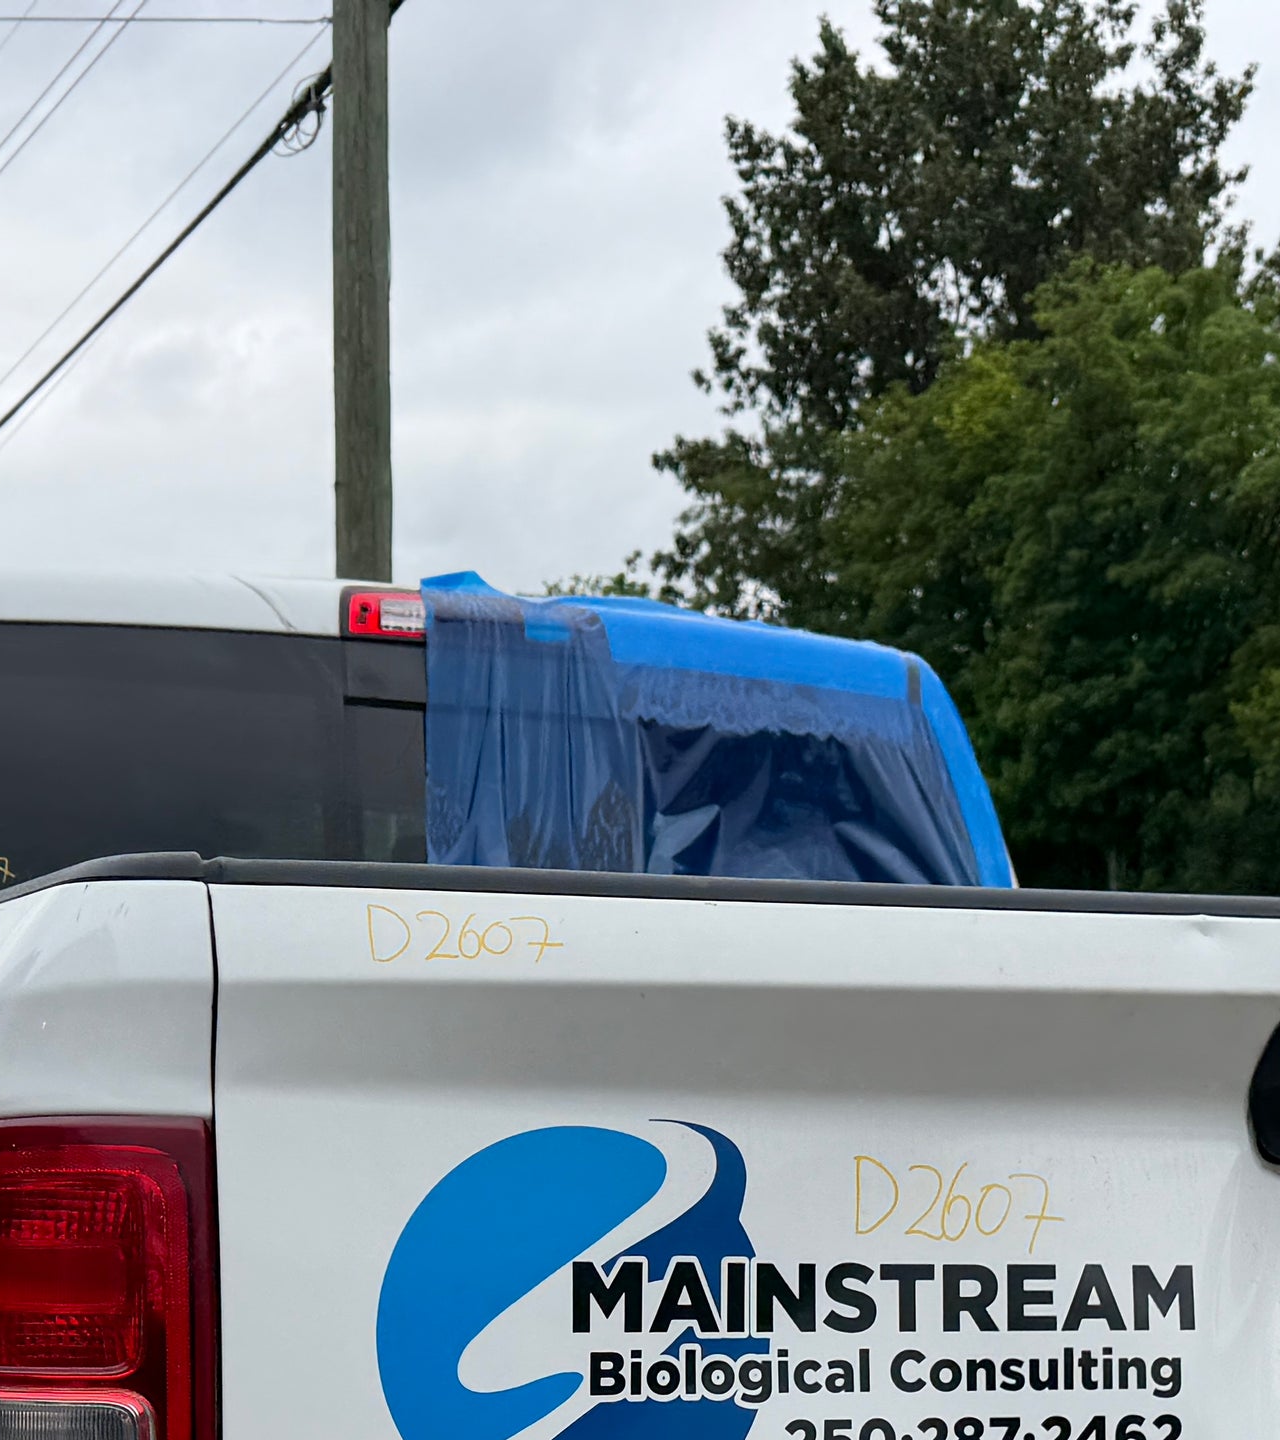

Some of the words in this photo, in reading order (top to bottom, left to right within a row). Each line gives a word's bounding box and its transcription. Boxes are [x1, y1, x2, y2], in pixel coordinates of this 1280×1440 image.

[367, 904, 564, 963] D2607
[853, 1155, 1065, 1254] D2607
[571, 1262, 1196, 1334] MAINSTREAM
[589, 1348, 870, 1402] Biological
[890, 1347, 1182, 1398] Consulting
